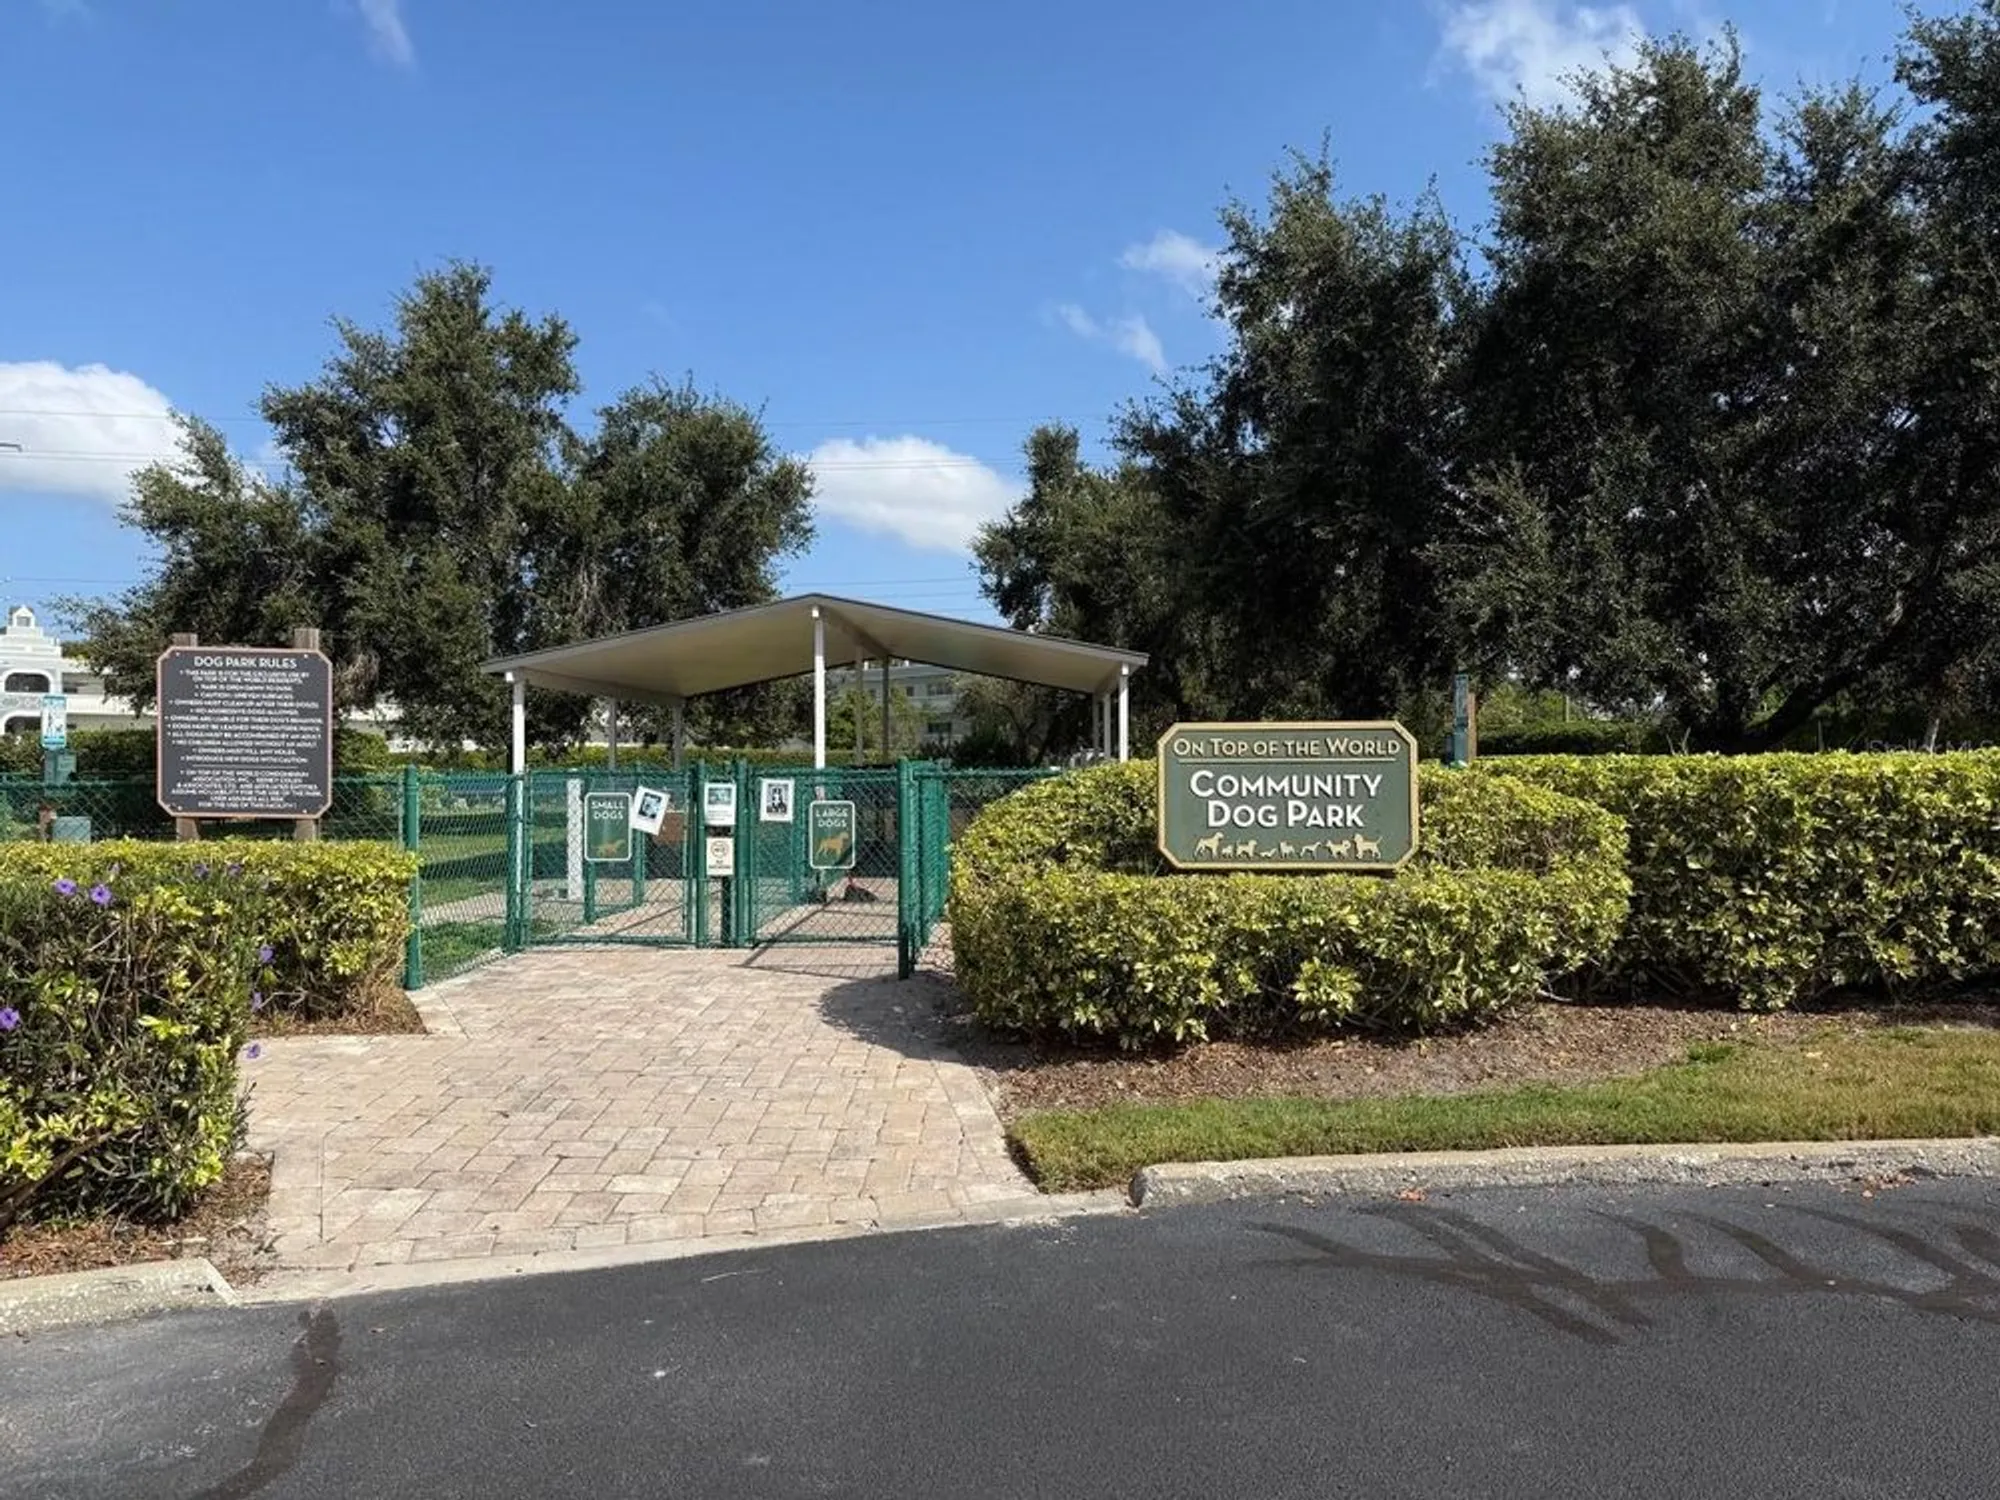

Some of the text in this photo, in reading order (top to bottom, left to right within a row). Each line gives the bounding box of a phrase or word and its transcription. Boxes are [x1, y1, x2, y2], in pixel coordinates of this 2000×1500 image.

[193, 655, 297, 669] DOG PARK RULES
[1174, 737, 1400, 756] ON TOP OF THE WORLD
[1189, 770, 1383, 798] COMMUNITY
[591, 800, 625, 810] SMALL
[593, 810, 624, 820] DOGS
[815, 807, 848, 818] LARGE
[1207, 800, 1365, 828] DOG PARK
[817, 819, 848, 828] DOGS
